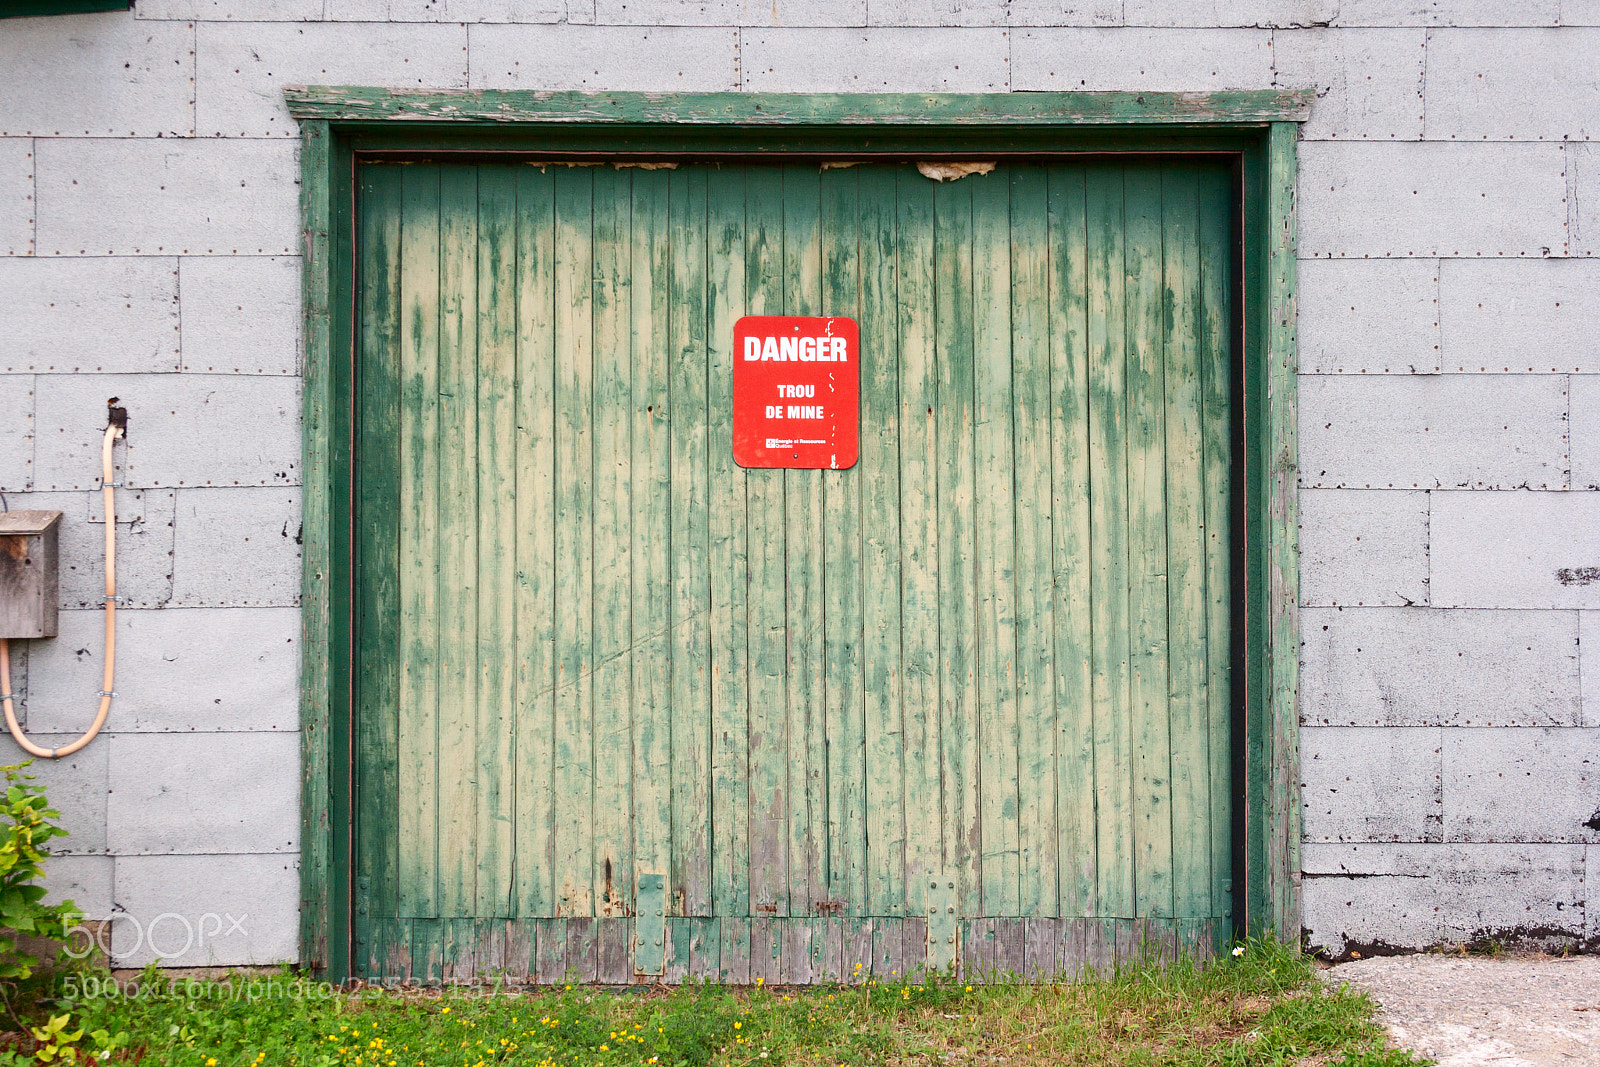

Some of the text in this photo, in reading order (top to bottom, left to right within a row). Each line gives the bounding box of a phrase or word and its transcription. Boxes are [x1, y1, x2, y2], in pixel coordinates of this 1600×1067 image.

[744, 336, 847, 362] DANGER
[777, 384, 815, 398] TROU
[765, 405, 824, 419] DE MINE
